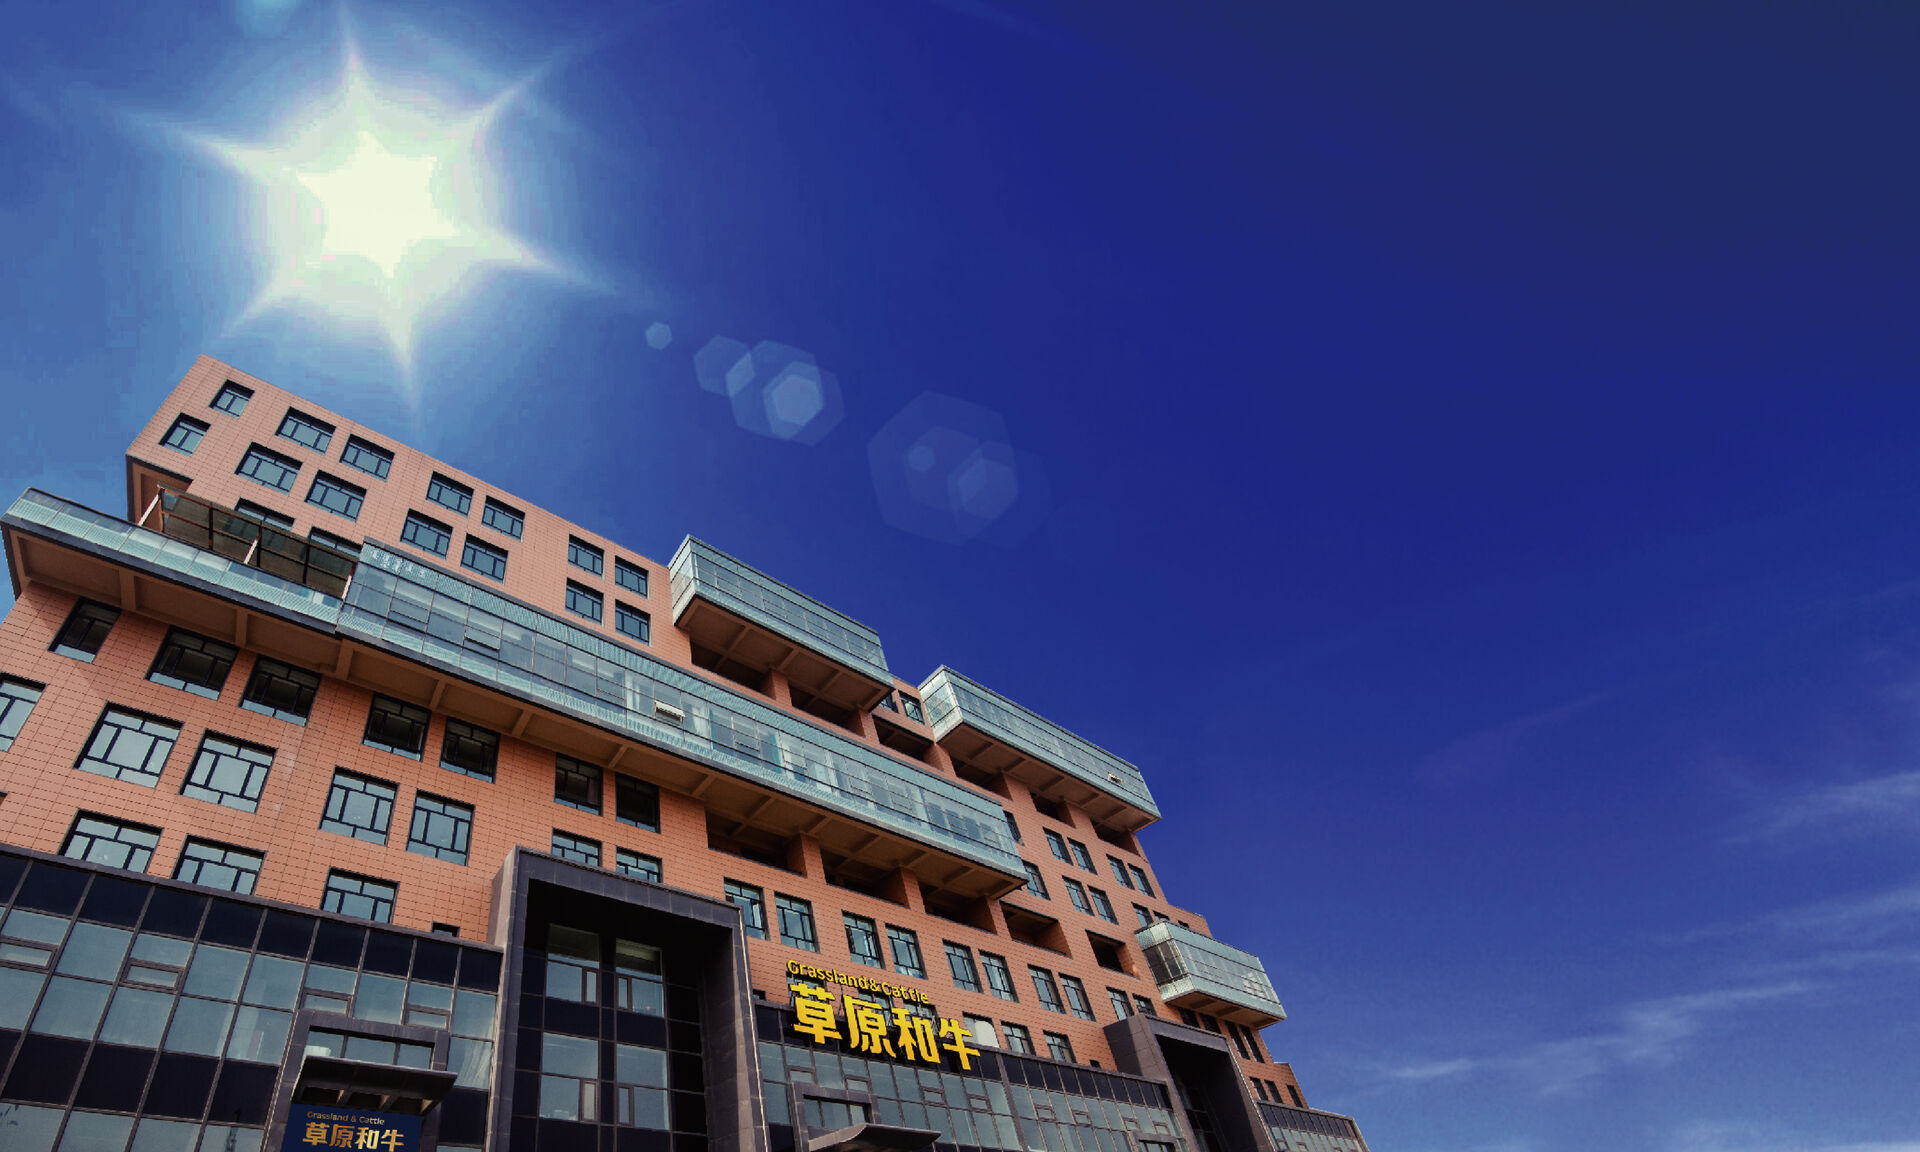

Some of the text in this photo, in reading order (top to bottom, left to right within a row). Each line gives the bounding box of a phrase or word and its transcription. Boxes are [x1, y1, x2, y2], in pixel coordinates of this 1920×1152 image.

[789, 982, 981, 1071] 草原和牛
[306, 1111, 349, 1122] Grassland
[359, 1116, 385, 1125] Cattle
[302, 1122, 405, 1152] 草原和牛
